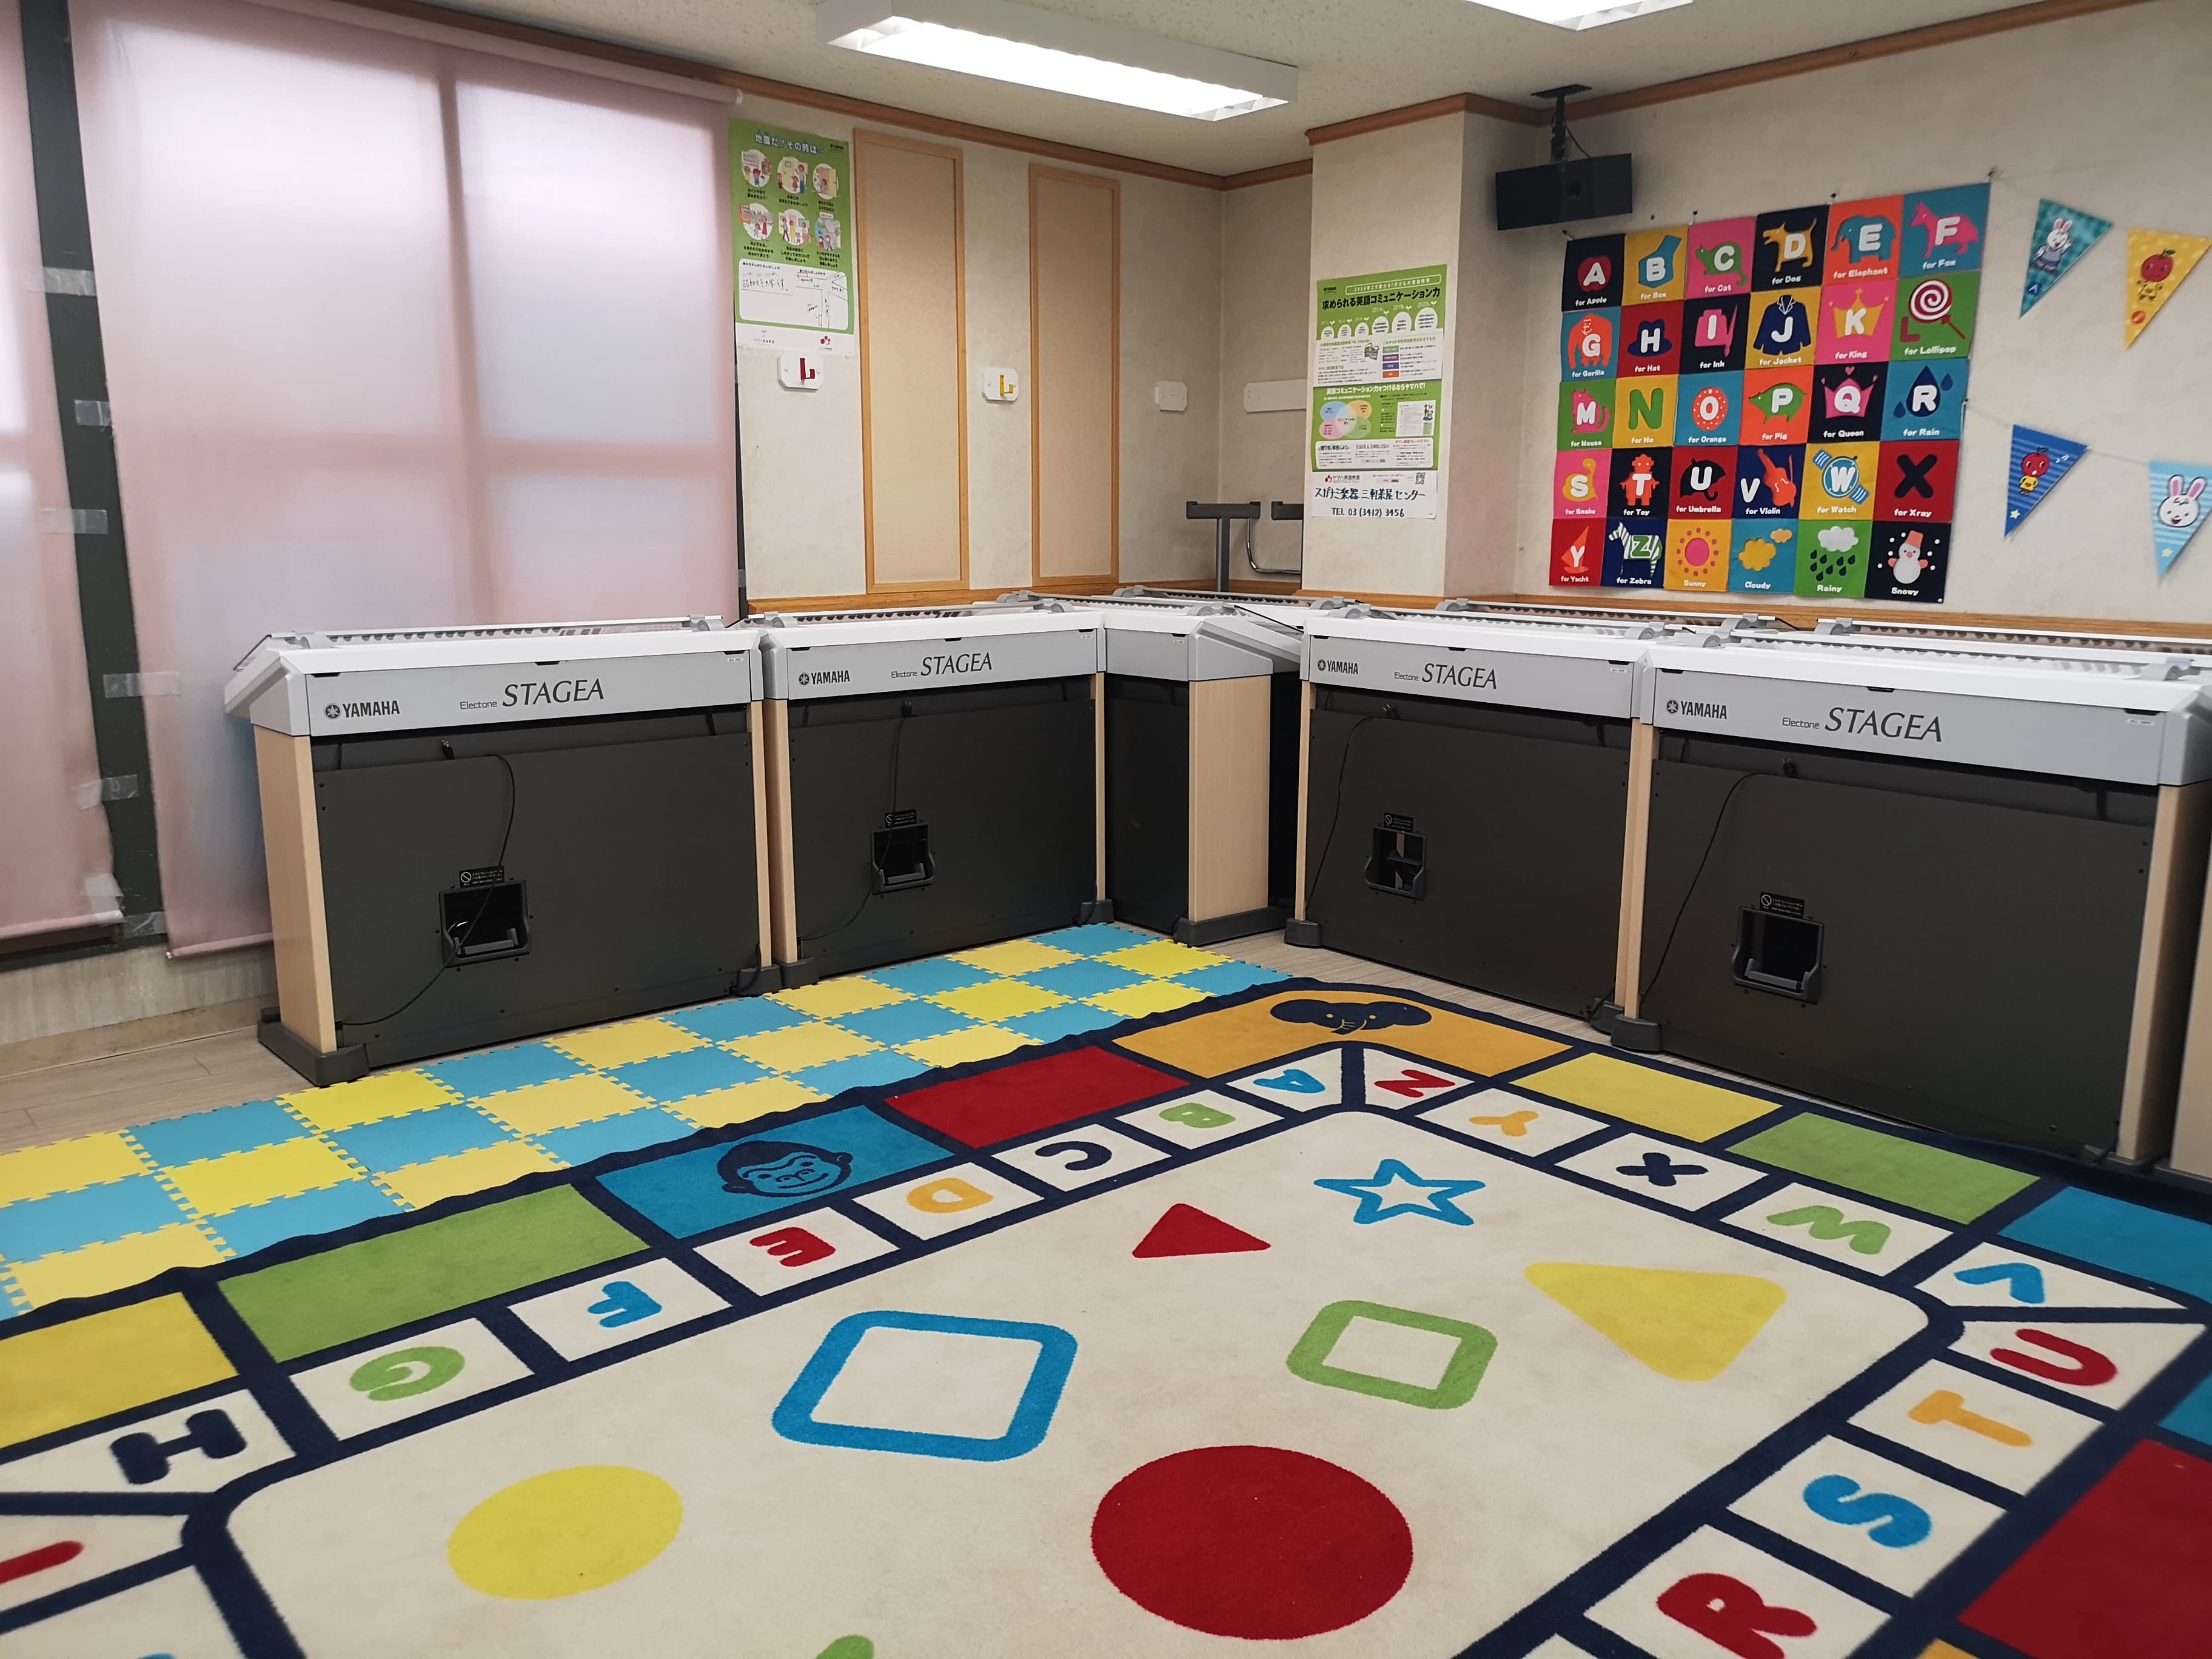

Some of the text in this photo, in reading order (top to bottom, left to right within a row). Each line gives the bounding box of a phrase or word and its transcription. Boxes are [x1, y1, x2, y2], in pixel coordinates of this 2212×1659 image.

[1858, 223, 1883, 252] E
[1935, 216, 1960, 246] F
[1714, 246, 1735, 271] C
[1784, 233, 1806, 260] D
[1583, 262, 1606, 287] A
[1646, 256, 1666, 282] B
[1834, 270, 1846, 279] for
[1922, 259, 1956, 270] for Fox
[1772, 275, 1801, 285] for Dog
[1322, 287, 1441, 310] 求められる英語コミュニケーション力
[1587, 297, 1607, 305] Apple
[1707, 315, 1717, 340] I
[1771, 316, 1794, 343] J
[1845, 308, 1867, 336] K
[1900, 316, 1921, 342] L
[1582, 333, 1601, 357] G
[1640, 327, 1660, 354] H
[1835, 350, 1868, 360] for King
[1628, 387, 1664, 430] N
[1700, 396, 1719, 421] O
[1771, 387, 1794, 414] P
[1834, 386, 1862, 415] Q
[1912, 384, 1937, 413] R
[1577, 401, 1596, 425] M
[1838, 429, 1864, 438] Queen
[1570, 475, 1589, 497] S
[1632, 473, 1652, 497] T
[1691, 466, 1713, 491] U
[1831, 466, 1856, 492] W
[1894, 454, 1938, 498] X
[1740, 477, 1760, 503] V
[1385, 508, 1404, 517] 3456
[1831, 505, 1857, 514] Watch
[1894, 508, 1932, 518] for Xray
[1570, 545, 1585, 568] Y
[1631, 535, 1652, 558] Z
[1571, 575, 1589, 583] Yacht
[1683, 580, 1706, 588] Sunny
[1744, 581, 1771, 590] Cloudy
[1891, 588, 1919, 596] Snowy
[811, 670, 850, 685] YAMAHA
[891, 652, 993, 679] Electone STAGEA
[1327, 660, 1359, 675] YAMAHA
[1394, 663, 1497, 689] Electone STAGEA
[460, 678, 605, 710] Electone STAGEA
[342, 700, 400, 718] YAMAHA
[1680, 700, 1728, 720] YAMAHA
[1782, 707, 1942, 743] Electone STAGEA
[1253, 1068, 1326, 1094] A
[1159, 1102, 1236, 1128] B
[1468, 1110, 1540, 1137] Y
[1034, 1141, 1112, 1171] C
[1615, 1152, 1709, 1187] X
[906, 1177, 994, 1214] D
[749, 1226, 837, 1267] E
[1954, 1262, 2045, 1304] V
[587, 1281, 663, 1328] F
[1990, 1328, 2118, 1387] U
[349, 1345, 465, 1402] G
[1906, 1389, 2033, 1447] T
[110, 1409, 247, 1485] H
[1803, 1473, 1932, 1548] S
[1656, 1572, 1818, 1659] R
